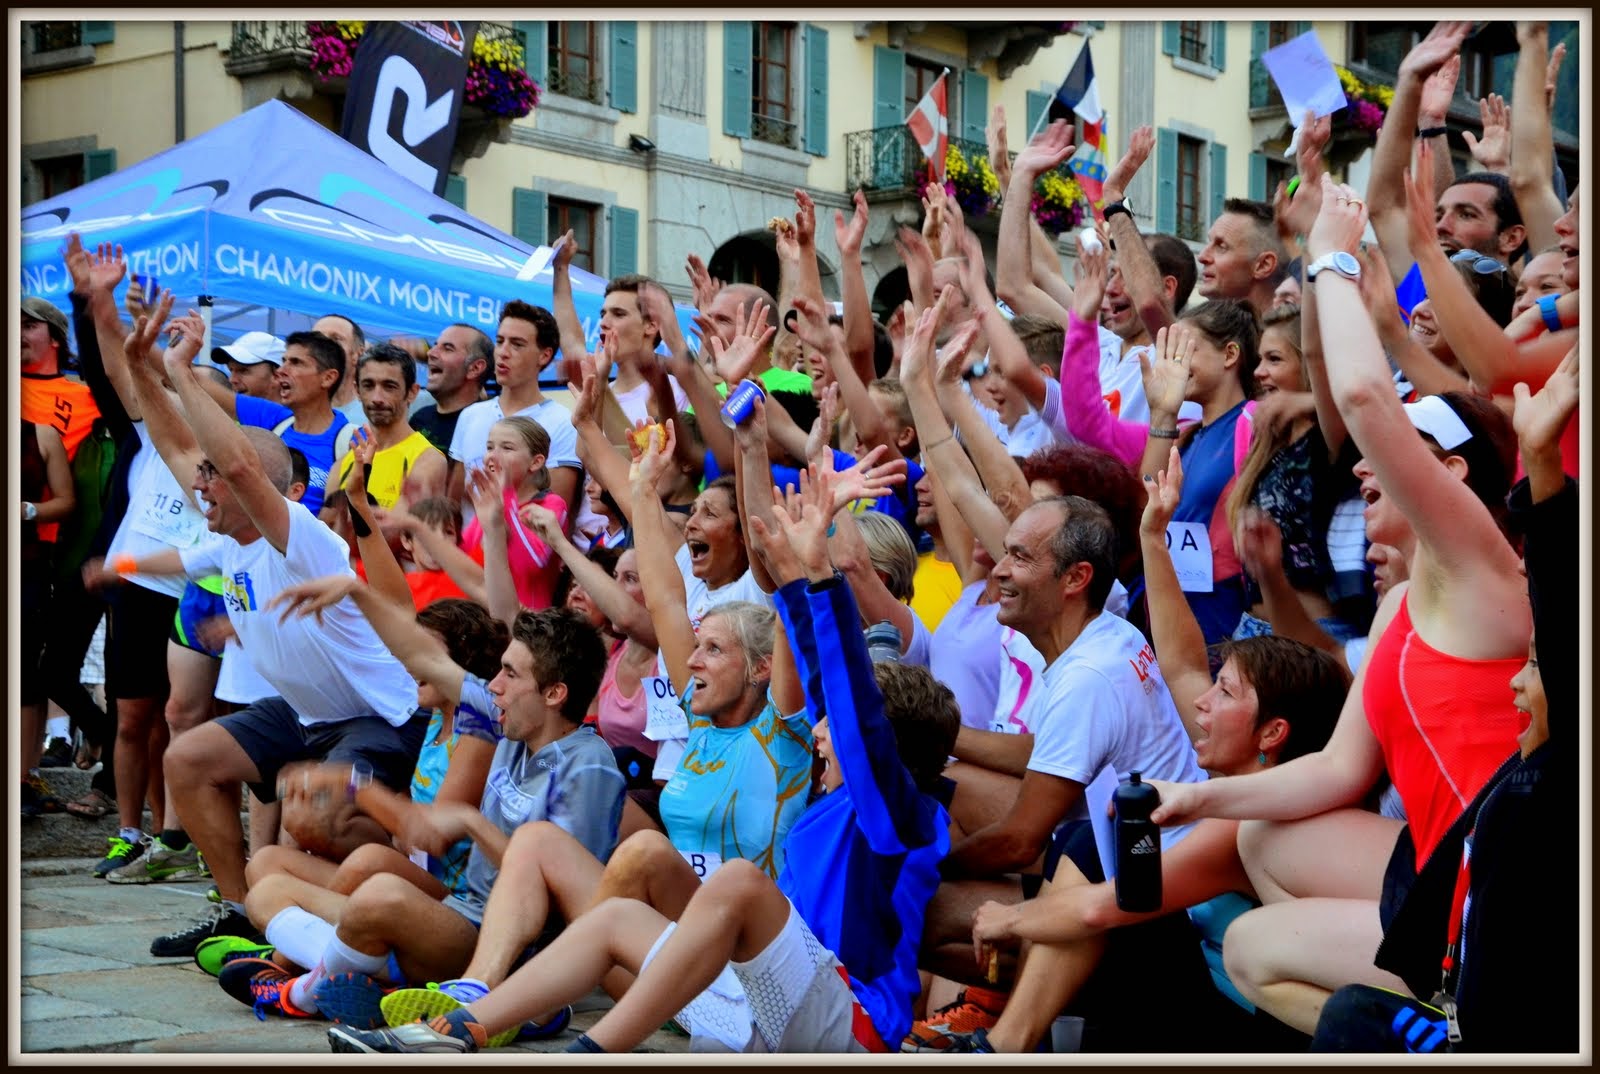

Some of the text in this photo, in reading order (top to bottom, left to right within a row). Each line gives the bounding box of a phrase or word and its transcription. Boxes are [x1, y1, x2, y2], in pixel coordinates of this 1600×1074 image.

[22, 263, 59, 295] NC
[215, 244, 382, 304] CHAMONIX
[153, 492, 184, 515] 11 B
[691, 853, 707, 878] B
